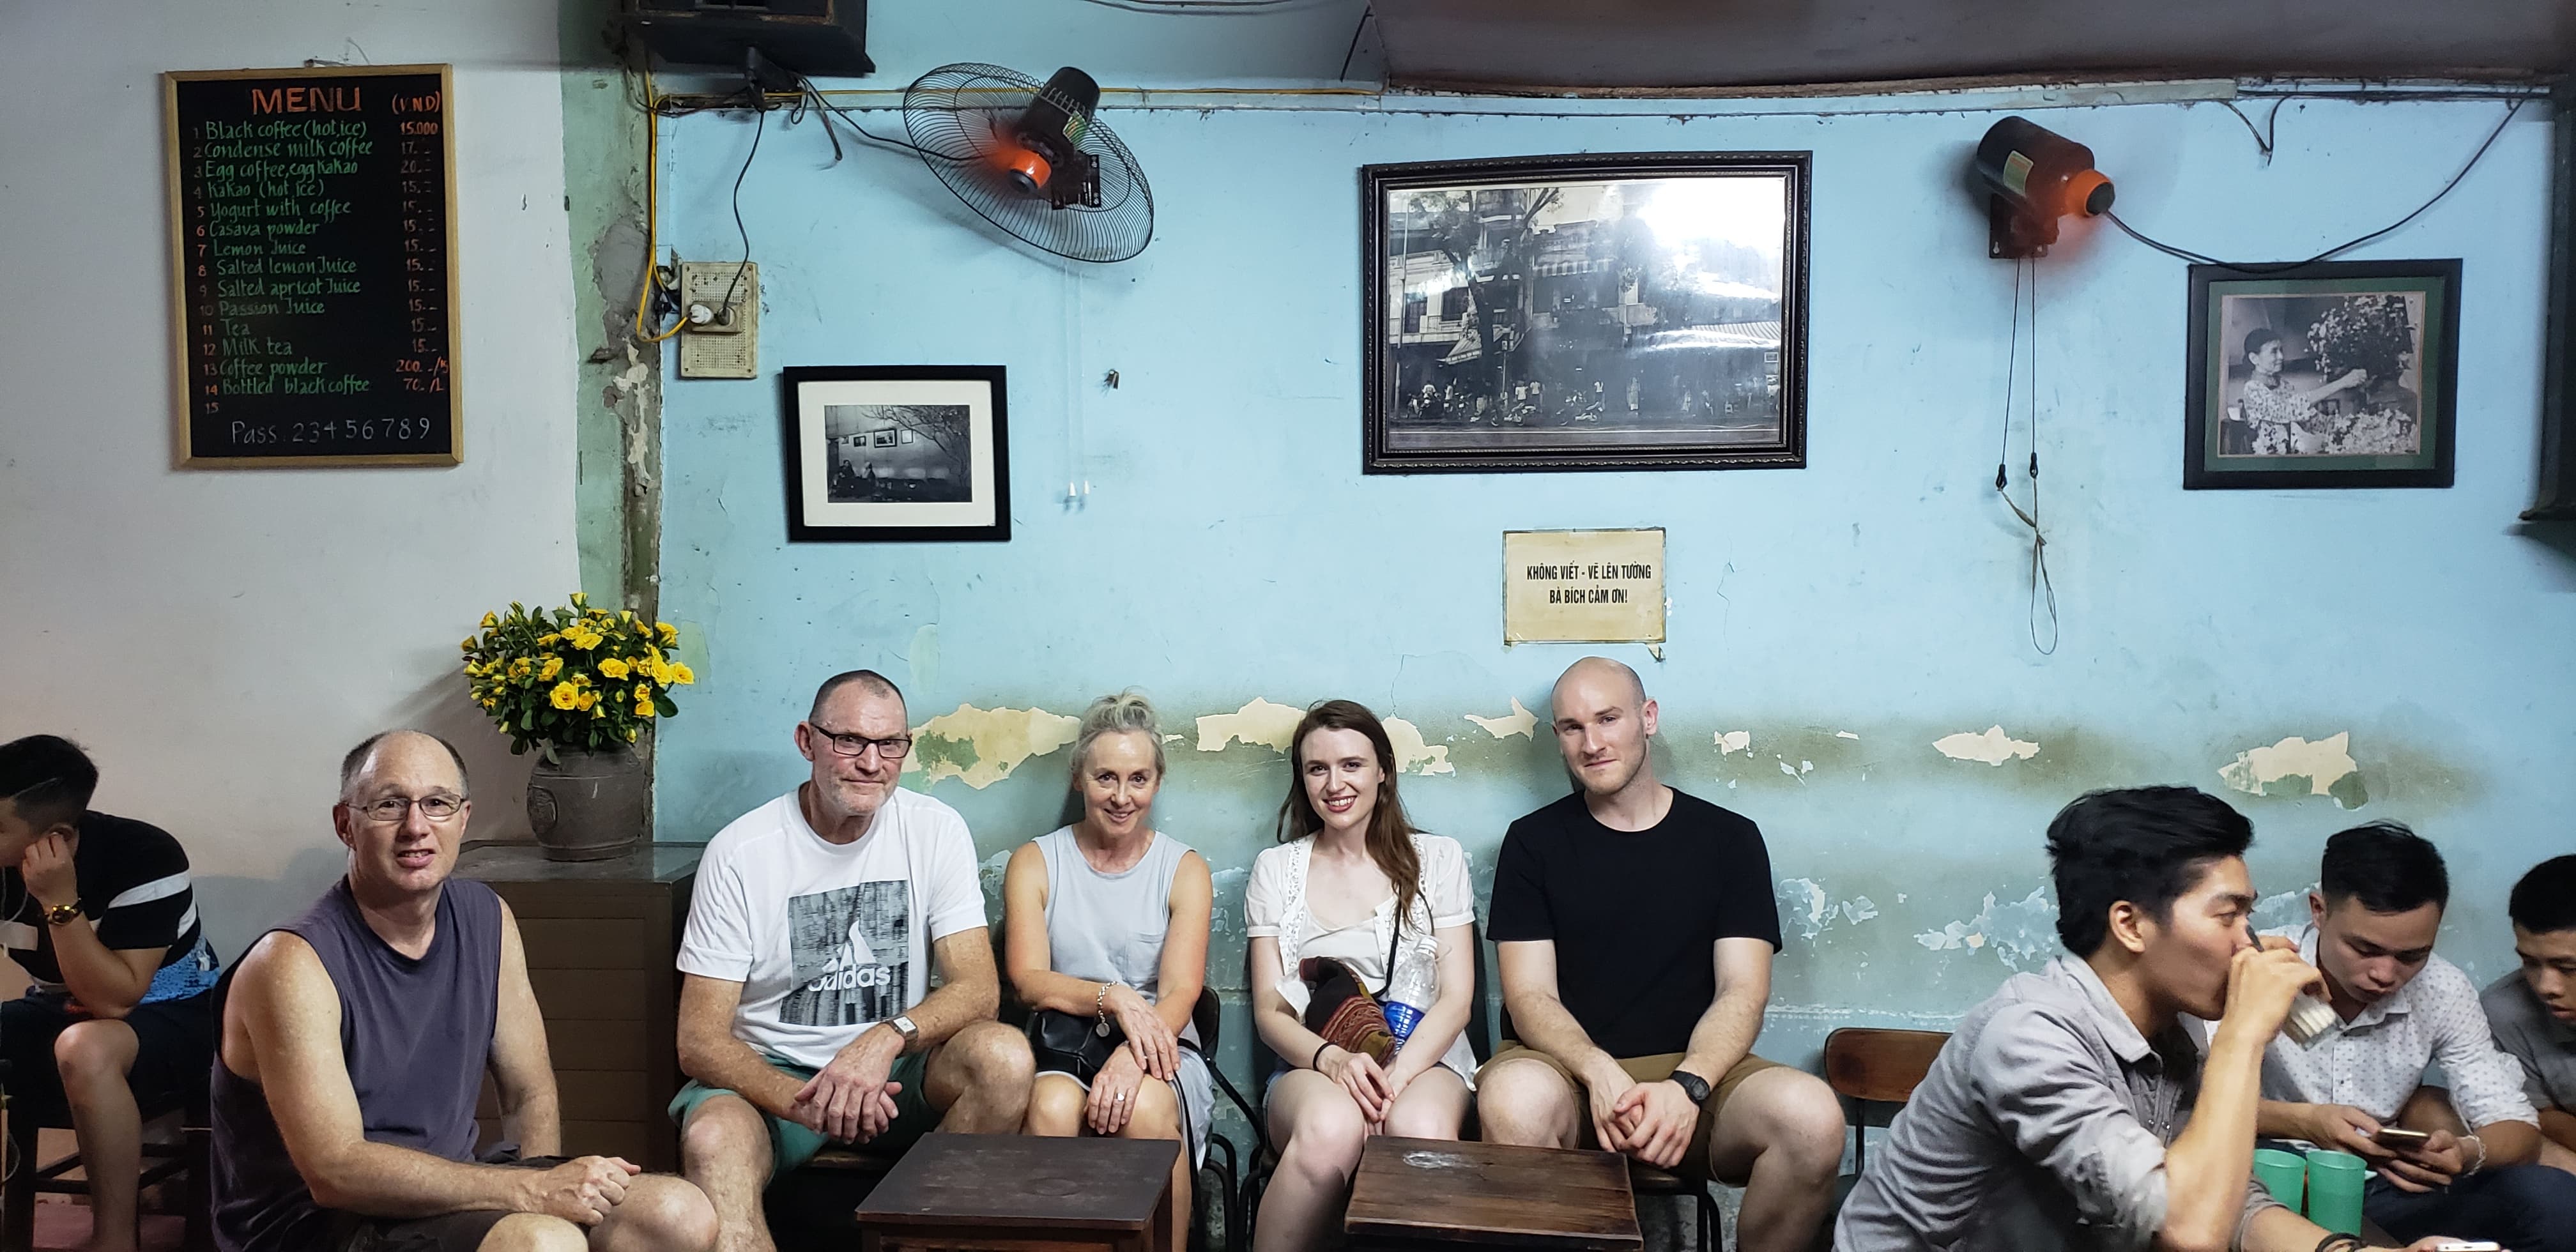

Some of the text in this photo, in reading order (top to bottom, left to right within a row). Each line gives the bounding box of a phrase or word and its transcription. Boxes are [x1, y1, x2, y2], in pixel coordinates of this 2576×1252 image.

[252, 87, 362, 115] MENU
[206, 120, 253, 139] Black
[257, 120, 302, 140] coffee
[194, 147, 203, 158] 2
[204, 139, 281, 158] Condense
[329, 137, 373, 159] coffee
[194, 165, 203, 178] 3
[205, 160, 234, 182] Egg
[193, 186, 202, 199] 4
[197, 206, 205, 218] 5
[210, 197, 261, 224] Yogurt
[266, 195, 300, 217] with
[310, 199, 351, 224] coffee
[196, 224, 205, 236] 6
[210, 220, 262, 237] Casava
[267, 218, 319, 241] powder
[197, 243, 208, 257] 7
[214, 238, 264, 257] Lemon
[198, 264, 206, 277] 8
[217, 257, 263, 275] Salted
[269, 257, 316, 274] lemon
[317, 256, 358, 273] Juice
[199, 284, 207, 297] 9
[218, 277, 264, 297] Salted
[270, 277, 323, 300] apricot
[325, 277, 361, 294] Juice
[200, 305, 214, 316] 10
[218, 300, 279, 316] Passion
[284, 297, 325, 314] Juice
[203, 324, 212, 336] 11
[219, 318, 250, 336] Tea
[203, 343, 216, 356] 12
[266, 337, 292, 355] tea
[204, 362, 218, 376] 13
[219, 358, 264, 379] Coffee
[270, 356, 327, 379] powder
[205, 385, 218, 396] 14
[222, 374, 274, 395] Bottled
[284, 376, 326, 394] black
[327, 374, 371, 395] coffee
[206, 402, 220, 415] 15
[1527, 562, 1558, 580] KHÔNG
[1560, 560, 1579, 580] VIẾT
[1601, 562, 1618, 579] LÊN
[1621, 561, 1652, 579] TƯỜNG
[1549, 586, 1561, 604] BÀ
[1565, 586, 1586, 604] BÍCH
